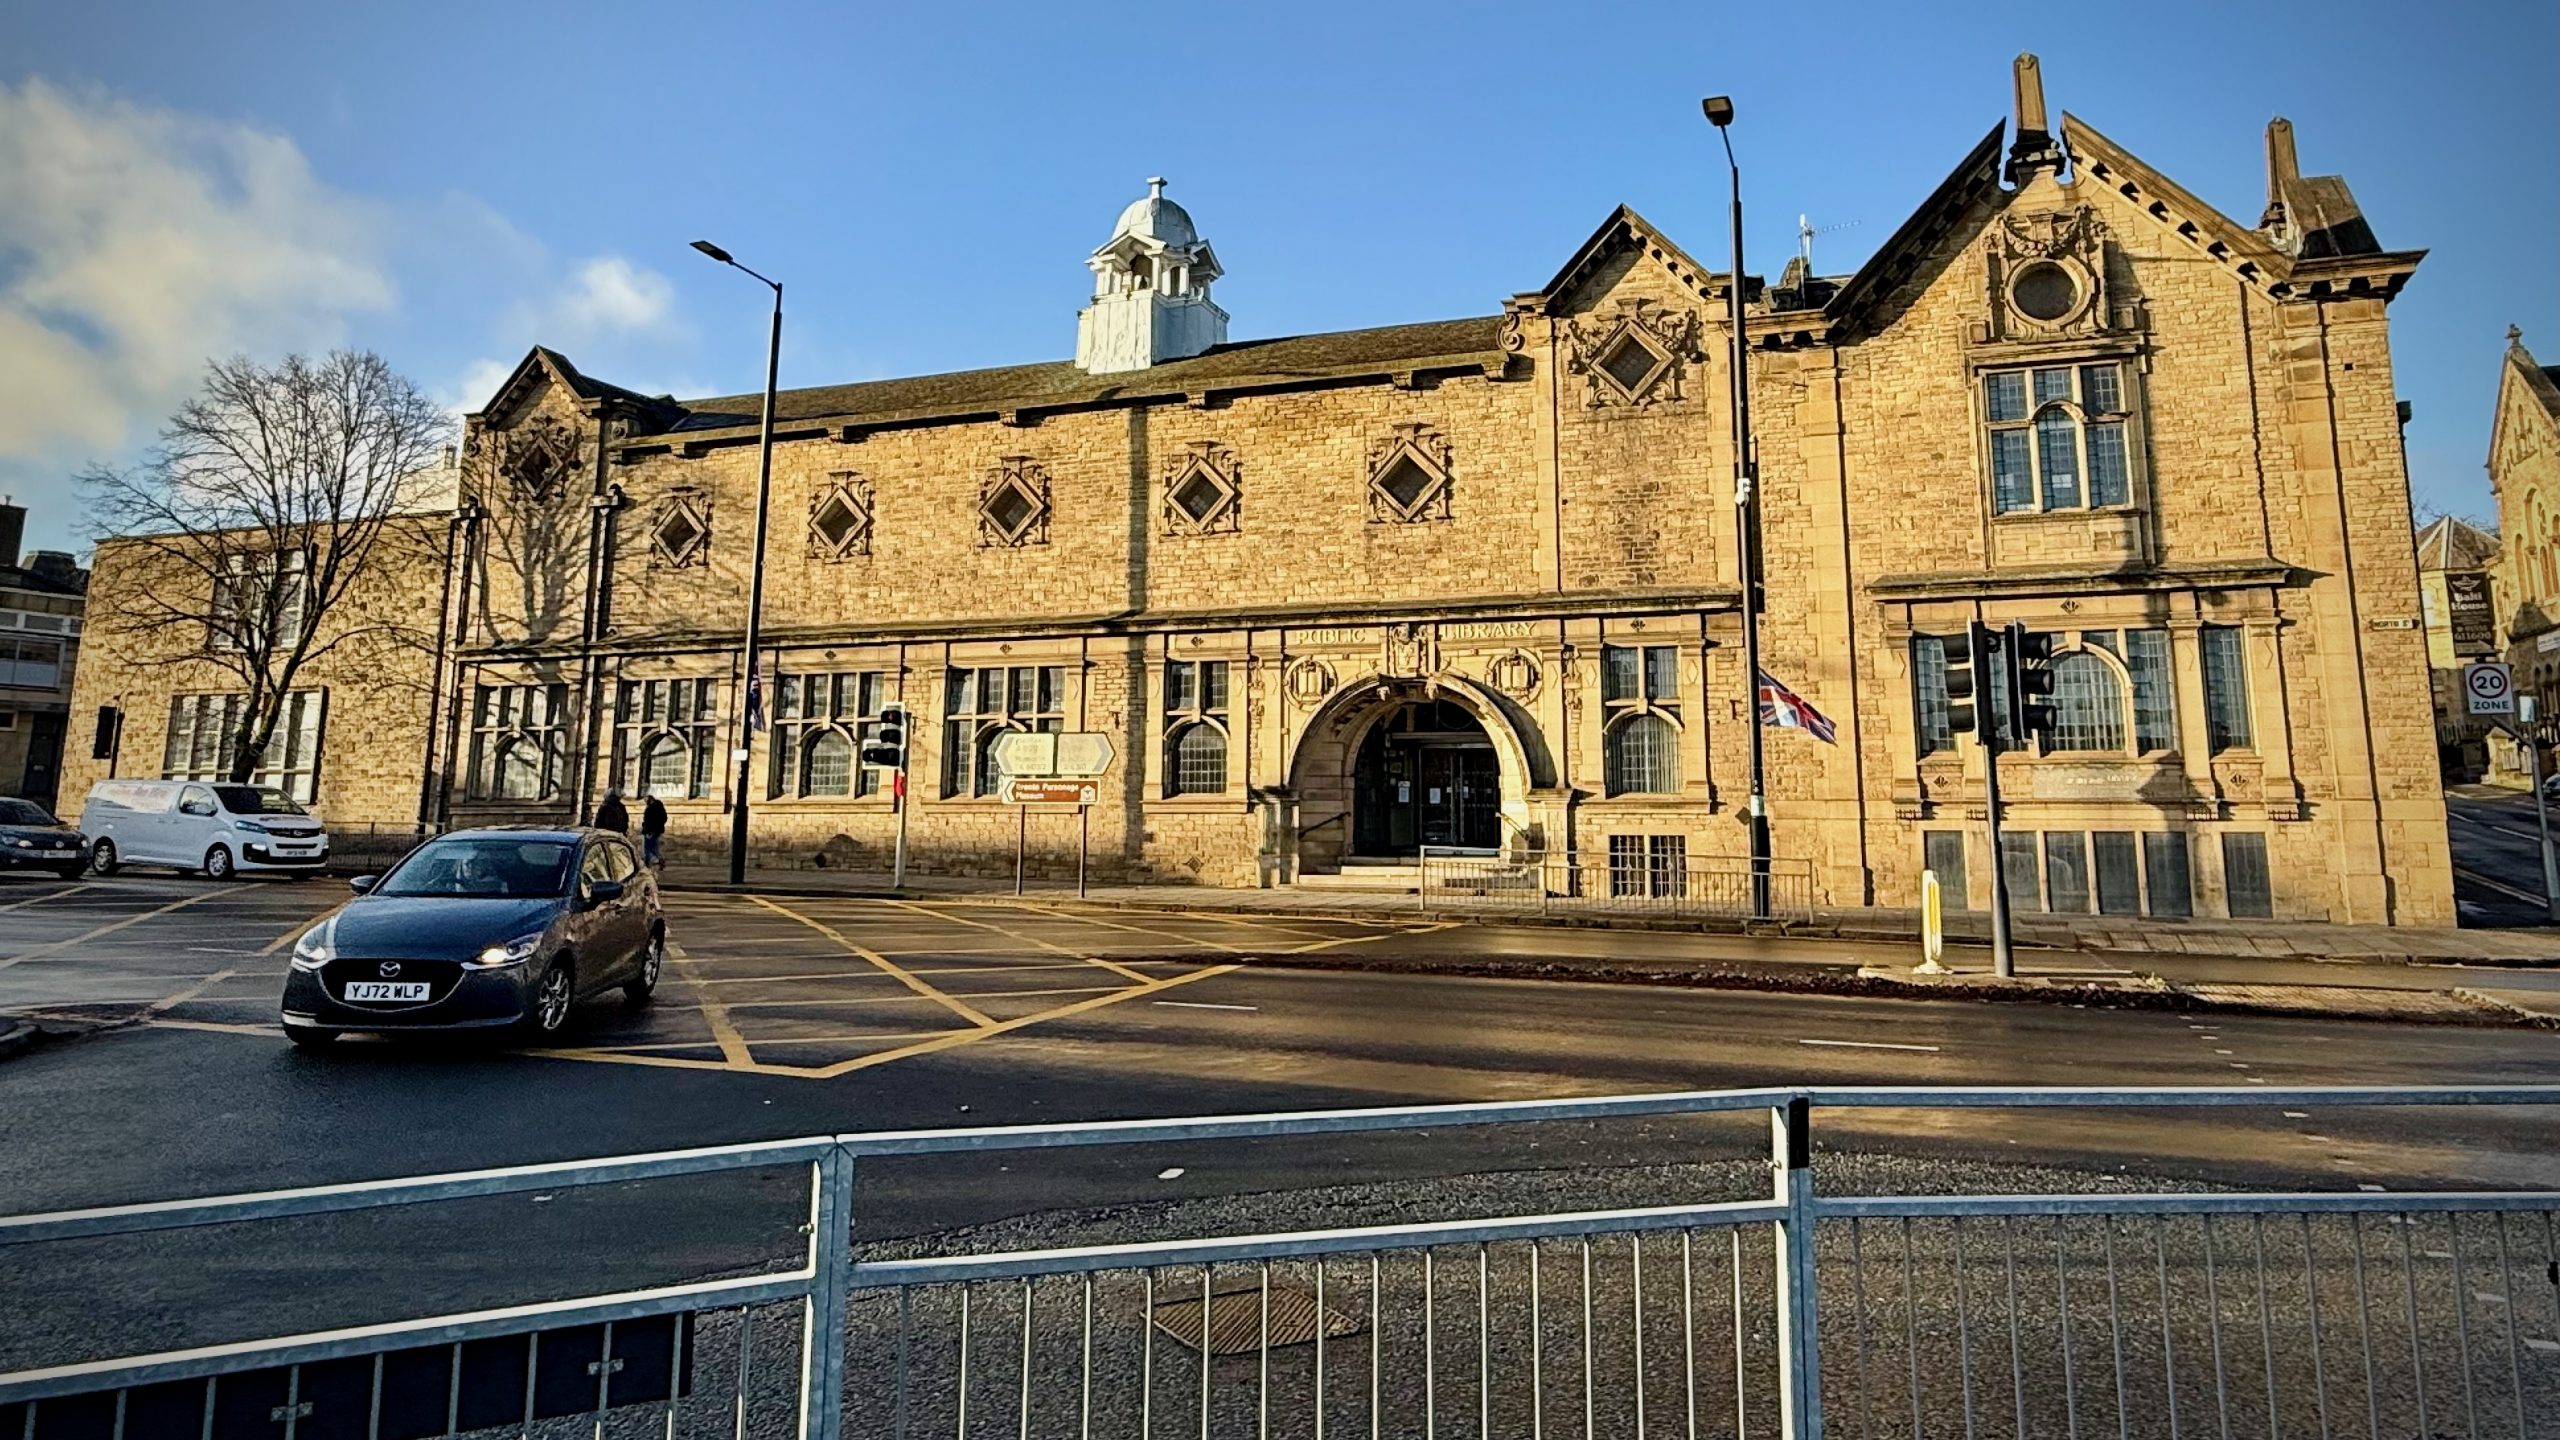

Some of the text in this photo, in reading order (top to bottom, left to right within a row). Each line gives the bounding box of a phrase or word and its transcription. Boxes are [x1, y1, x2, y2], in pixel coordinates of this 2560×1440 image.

[2454, 592, 2483, 602] Balti
[2451, 602, 2488, 611] House
[1295, 621, 1537, 645] PUBLIC LIBRARY
[2475, 676, 2503, 690] 20
[2473, 700, 2510, 710] ZONE
[352, 984, 424, 998] YJ72 WLP
